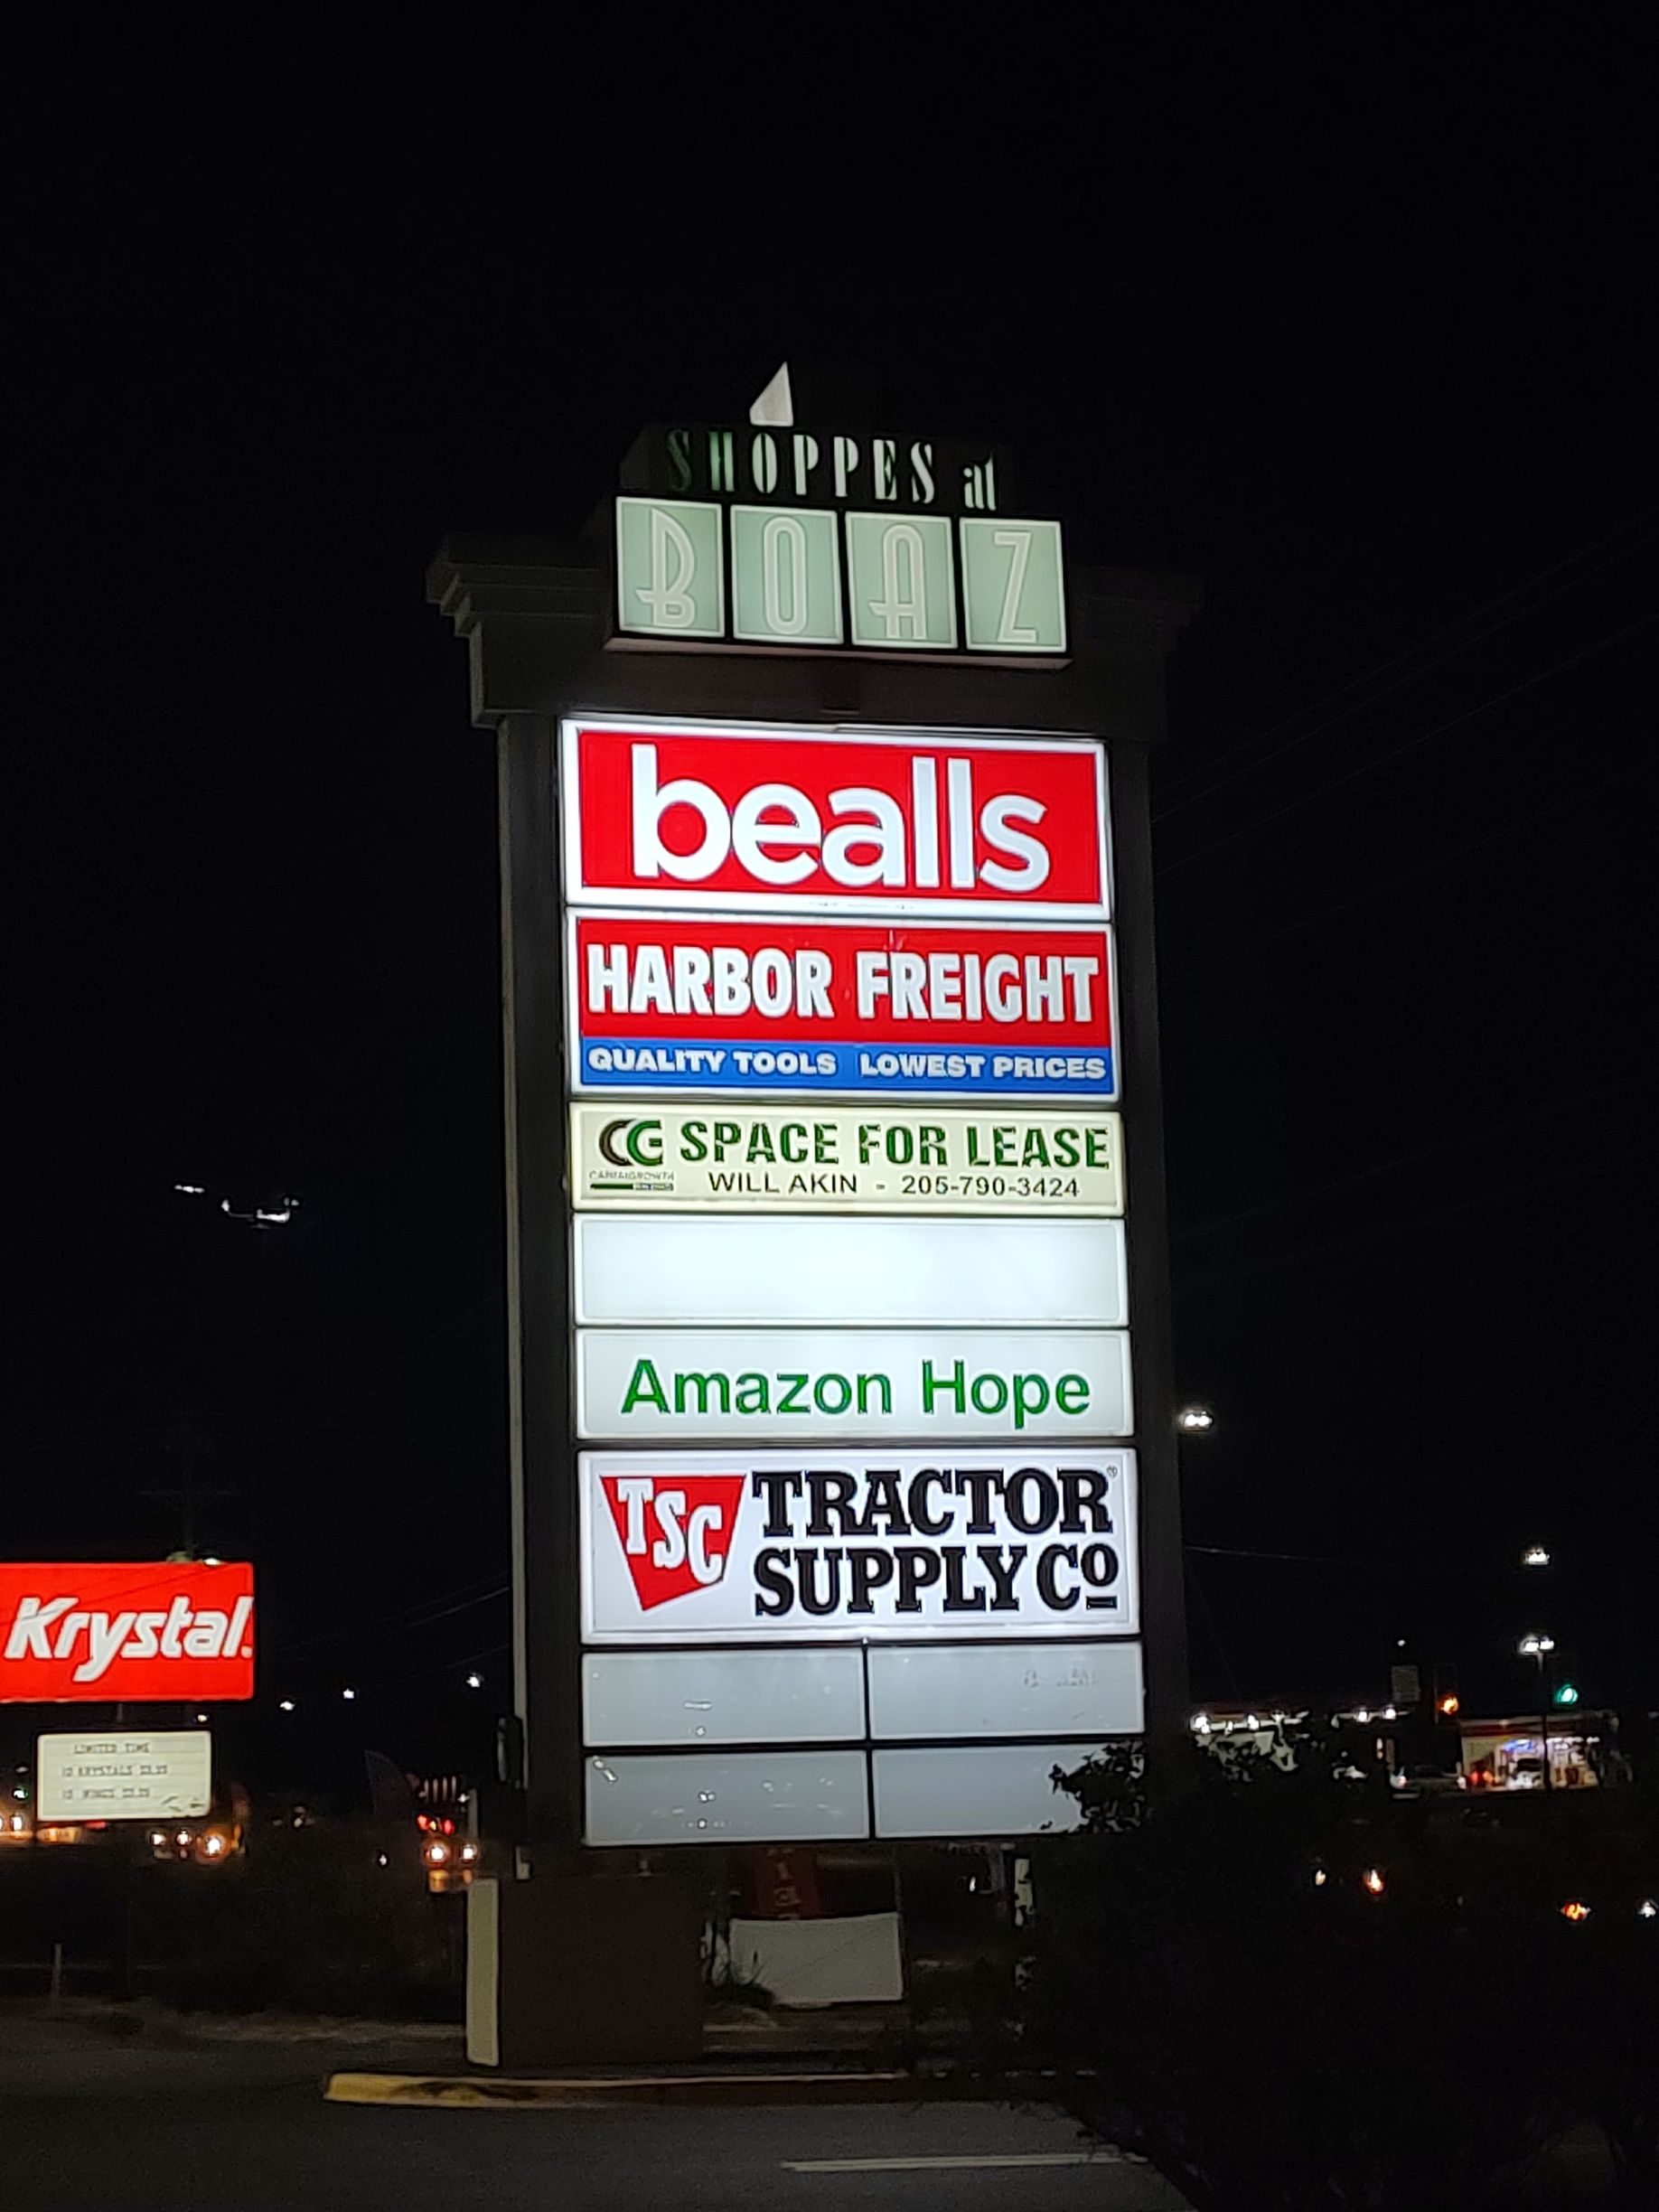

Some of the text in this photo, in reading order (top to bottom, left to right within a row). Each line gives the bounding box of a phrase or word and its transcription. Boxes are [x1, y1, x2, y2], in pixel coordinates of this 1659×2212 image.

[667, 428, 997, 511] SHOPPES at
[634, 507, 1038, 643] BOAZ
[631, 743, 1051, 893] bealls
[586, 943, 1100, 1023] HARBOR FREIGHT
[588, 1049, 1106, 1080] QUALITY TOOLS LOWEST PRICES
[680, 1120, 1110, 1169] SPACE FOR LEASE
[708, 1172, 781, 1194] WILL
[787, 1173, 858, 1195] AKIN
[901, 1175, 1081, 1198] 205-790-3424
[620, 1358, 1091, 1429] Amazon Hope
[616, 1476, 724, 1585] TSC
[752, 1467, 1113, 1537] TRACTOR
[755, 1544, 1028, 1616] SUPPLY
